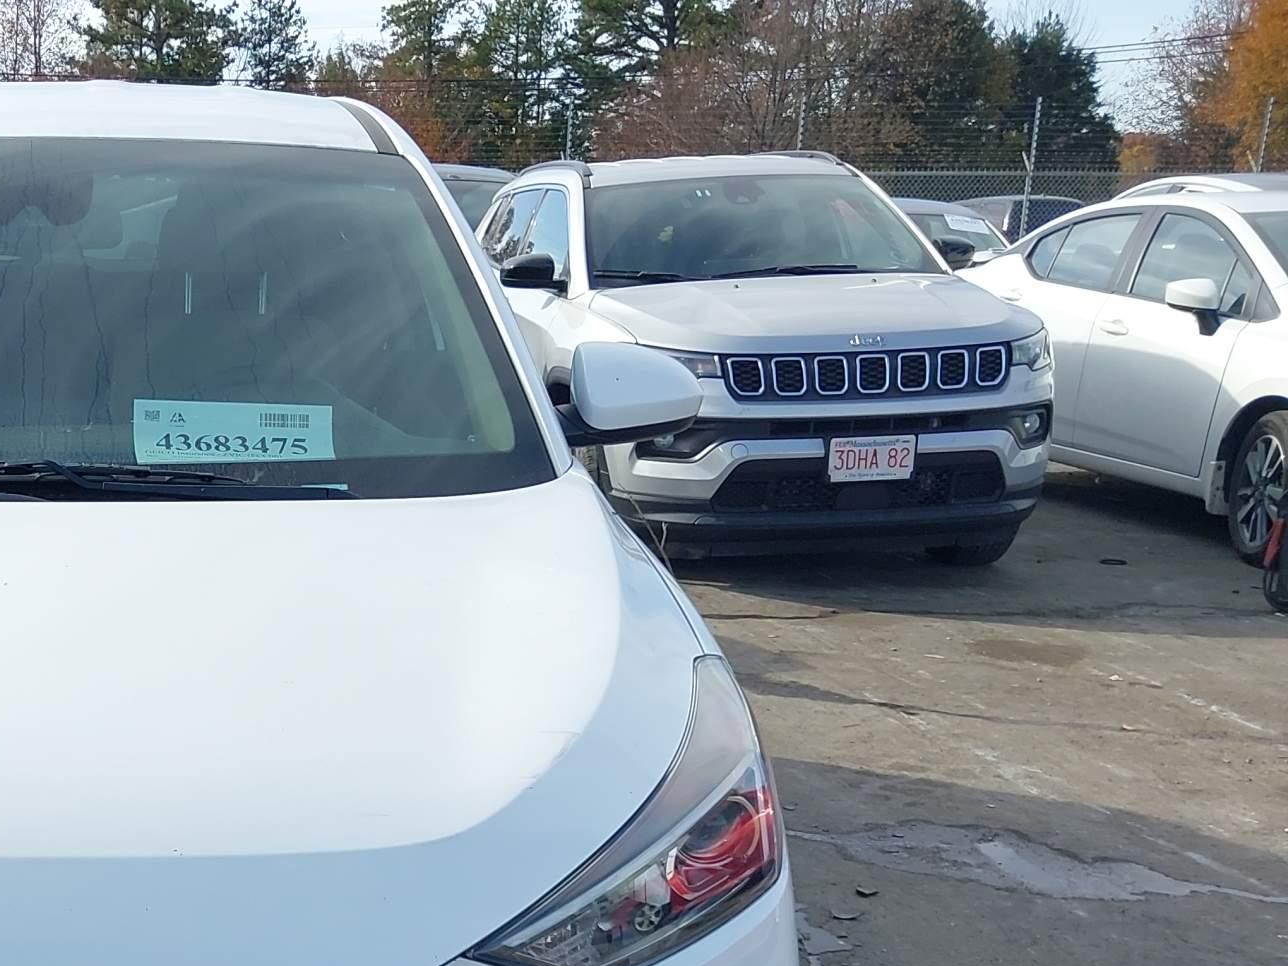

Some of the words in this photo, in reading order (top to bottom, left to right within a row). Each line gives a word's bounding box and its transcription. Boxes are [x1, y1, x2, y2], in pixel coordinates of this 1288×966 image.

[155, 433, 309, 456] 43683475
[833, 448, 879, 471] 3DHA
[887, 447, 911, 469] 82
